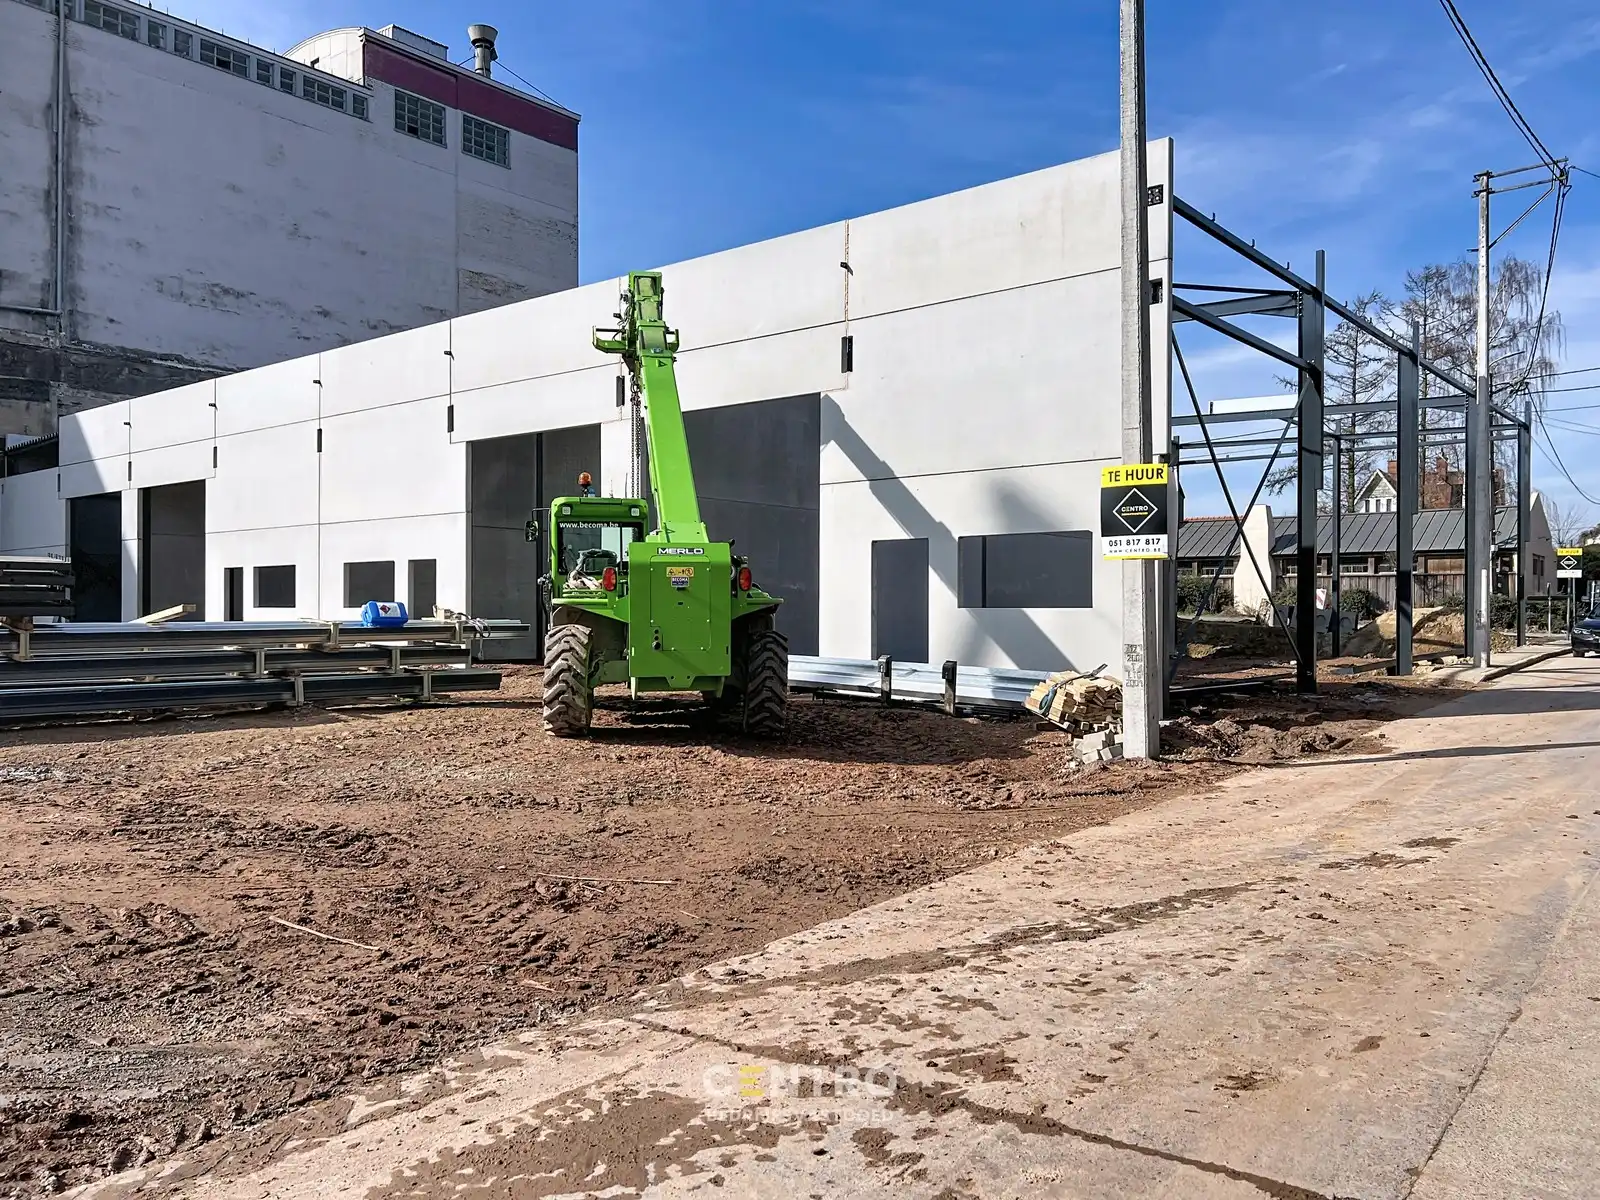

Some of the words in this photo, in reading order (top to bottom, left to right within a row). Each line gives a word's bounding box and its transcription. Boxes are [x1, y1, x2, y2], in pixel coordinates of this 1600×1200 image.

[1108, 470, 1120, 482] TE
[1125, 468, 1164, 481] HUUR
[559, 521, 619, 529] www.becoma.be
[1109, 539, 1122, 547] 051
